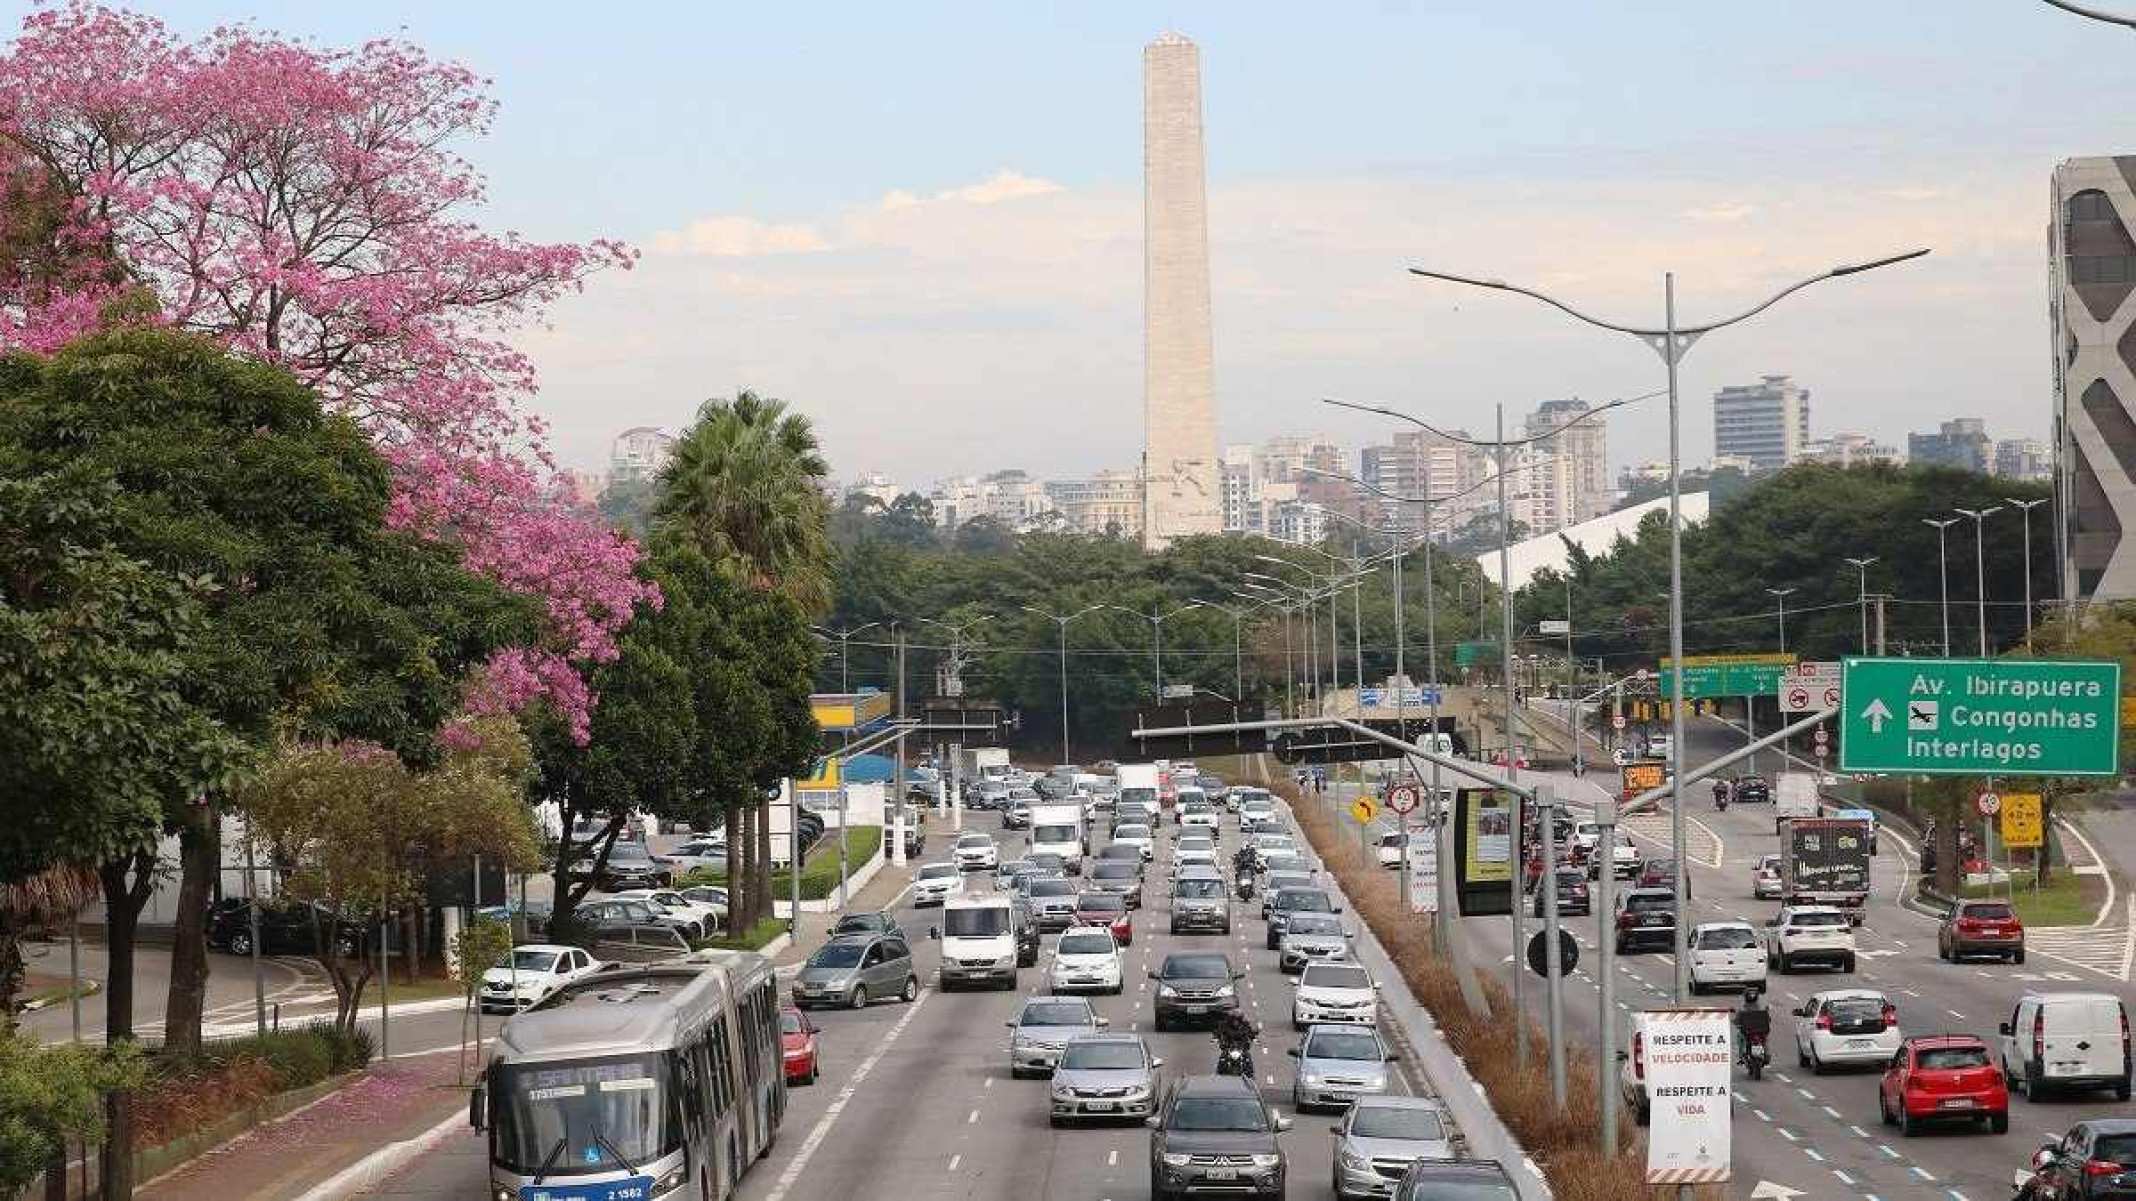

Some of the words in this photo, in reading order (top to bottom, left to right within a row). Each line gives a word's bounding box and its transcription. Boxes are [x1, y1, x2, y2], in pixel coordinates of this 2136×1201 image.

[1910, 674, 1952, 695] Av.
[1966, 674, 2102, 701] Ibirapuera
[1950, 706, 2098, 733] Congonhas
[1907, 737, 2043, 764] Interlagos
[1653, 1035, 1712, 1045] RESPEITE
[1717, 1035, 1726, 1044] A
[1652, 1052, 1729, 1063] VELOCIDADE
[1656, 1086, 1713, 1097] RESPEITE
[1718, 1086, 1727, 1096] A
[1679, 1103, 1706, 1115] VIDA
